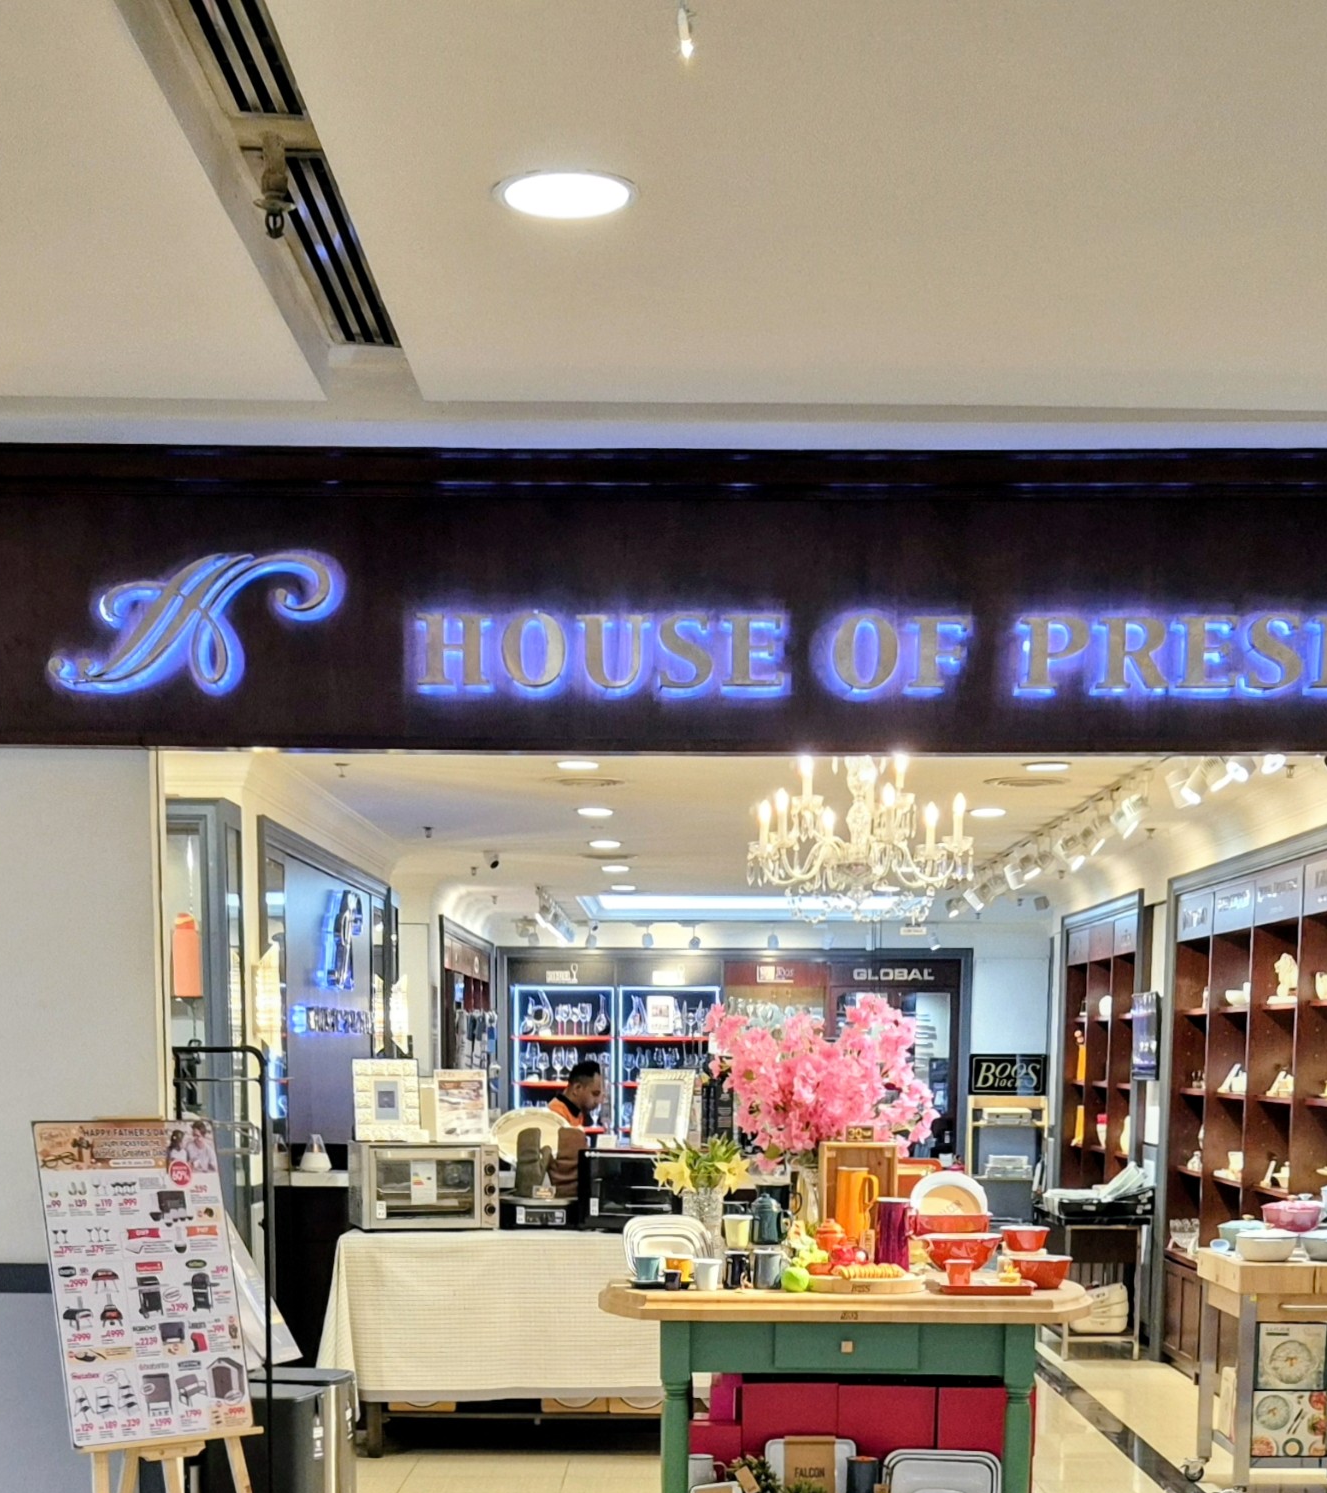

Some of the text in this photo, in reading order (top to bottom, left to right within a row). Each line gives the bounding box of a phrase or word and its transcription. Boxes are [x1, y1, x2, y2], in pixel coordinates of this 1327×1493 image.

[413, 610, 787, 697] HOUSE
[831, 610, 970, 697] OF
[853, 968, 933, 981] GLOBAL
[974, 1061, 1041, 1089] BOOS
[83, 1128, 111, 1137] HAPPY
[153, 1128, 169, 1137] DAY
[794, 1466, 826, 1479] FALCON
